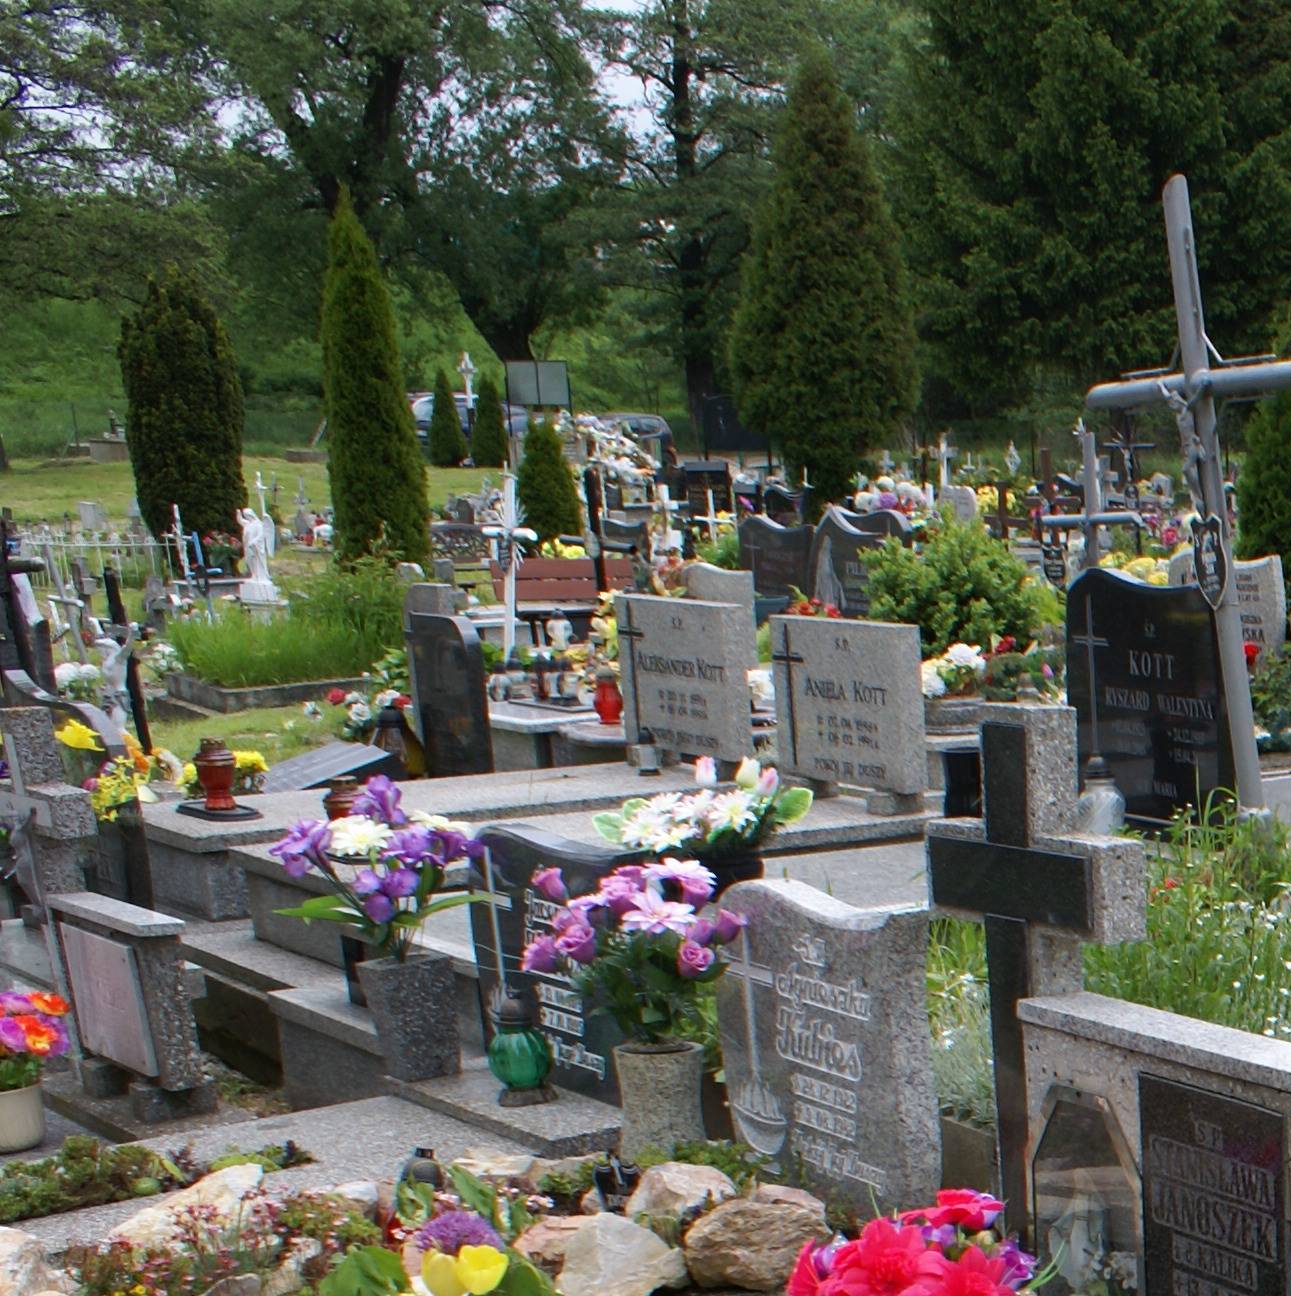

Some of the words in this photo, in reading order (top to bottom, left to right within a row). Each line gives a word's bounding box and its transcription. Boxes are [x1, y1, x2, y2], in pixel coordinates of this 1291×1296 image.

[696, 657, 726, 683] KOTT
[1129, 650, 1176, 680] KOTT
[853, 681, 888, 706] KOTT
[1105, 686, 1150, 712] RYSZARD
